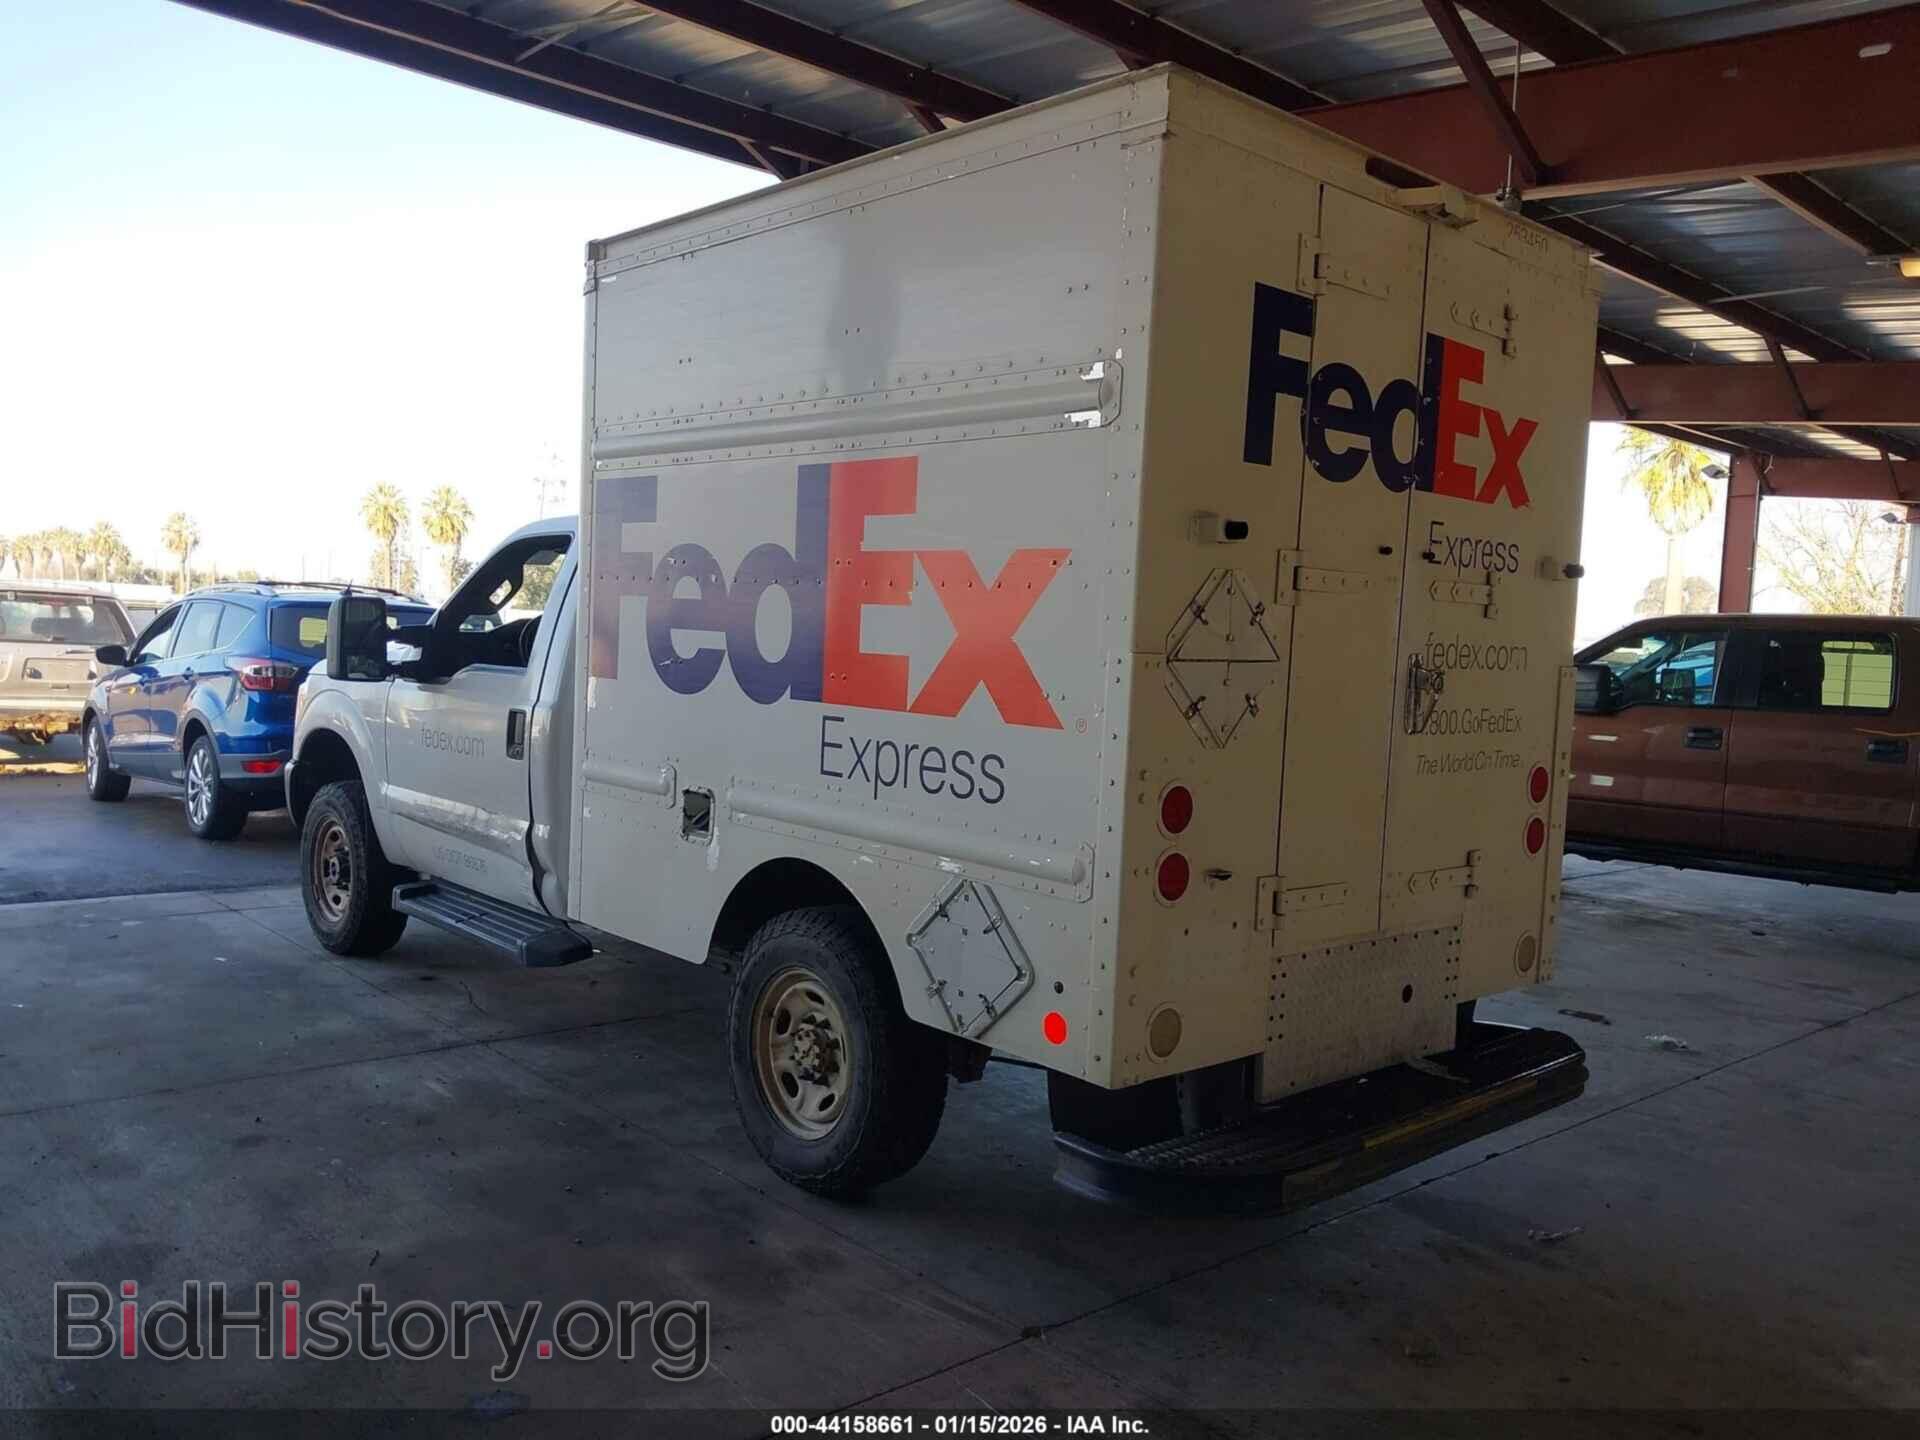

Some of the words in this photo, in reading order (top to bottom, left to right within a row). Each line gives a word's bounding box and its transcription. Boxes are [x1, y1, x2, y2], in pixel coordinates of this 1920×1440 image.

[1244, 281, 1538, 509] FedEx
[1428, 521, 1520, 577] Express
[589, 456, 1072, 730] FedEx
[1425, 631, 1528, 671] fedex.com
[420, 727, 486, 758] fedex.com
[820, 716, 1006, 804] Express
